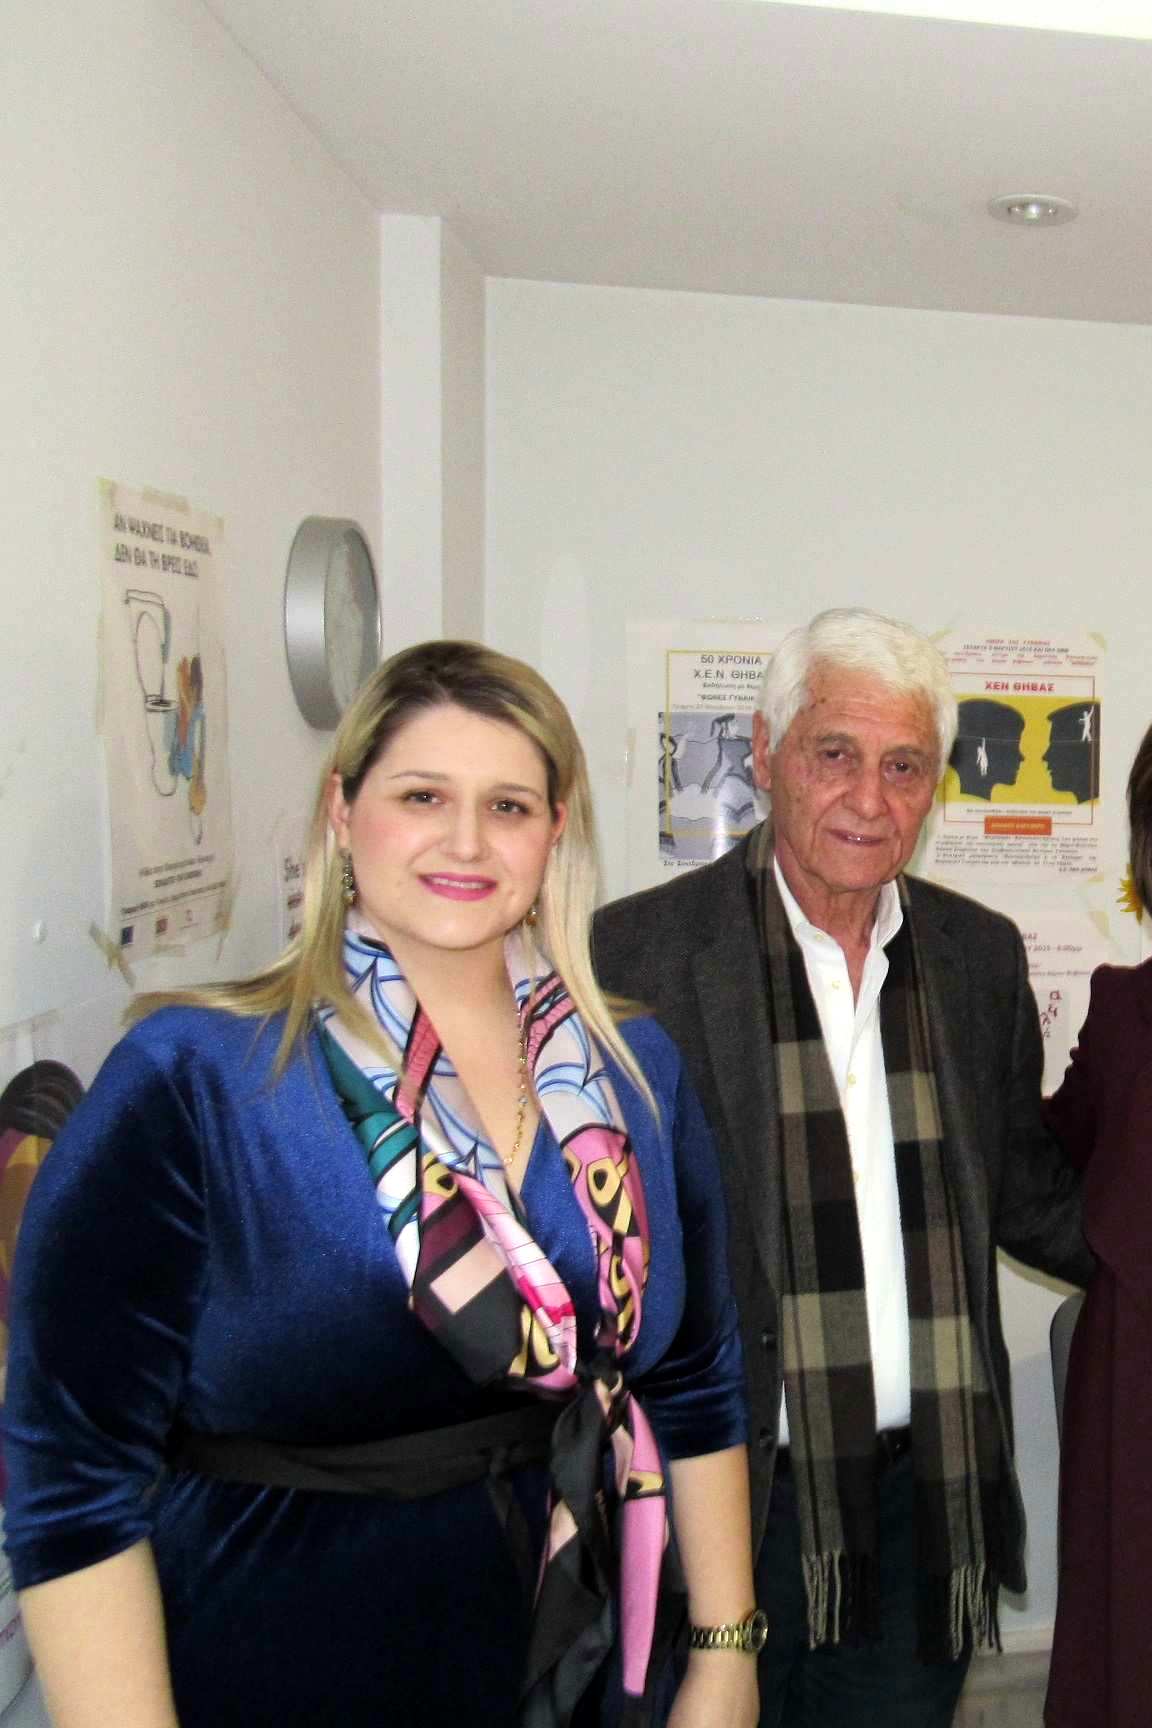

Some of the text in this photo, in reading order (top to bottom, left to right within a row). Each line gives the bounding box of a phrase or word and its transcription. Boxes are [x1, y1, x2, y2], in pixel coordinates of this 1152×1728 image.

[700, 654, 762, 665] 50 ΧΡΟΝΙΑ
[731, 670, 764, 680] ΘΗΒΑ
[985, 680, 1055, 692] ΧΕΝ ΘΗΒΑΣ
